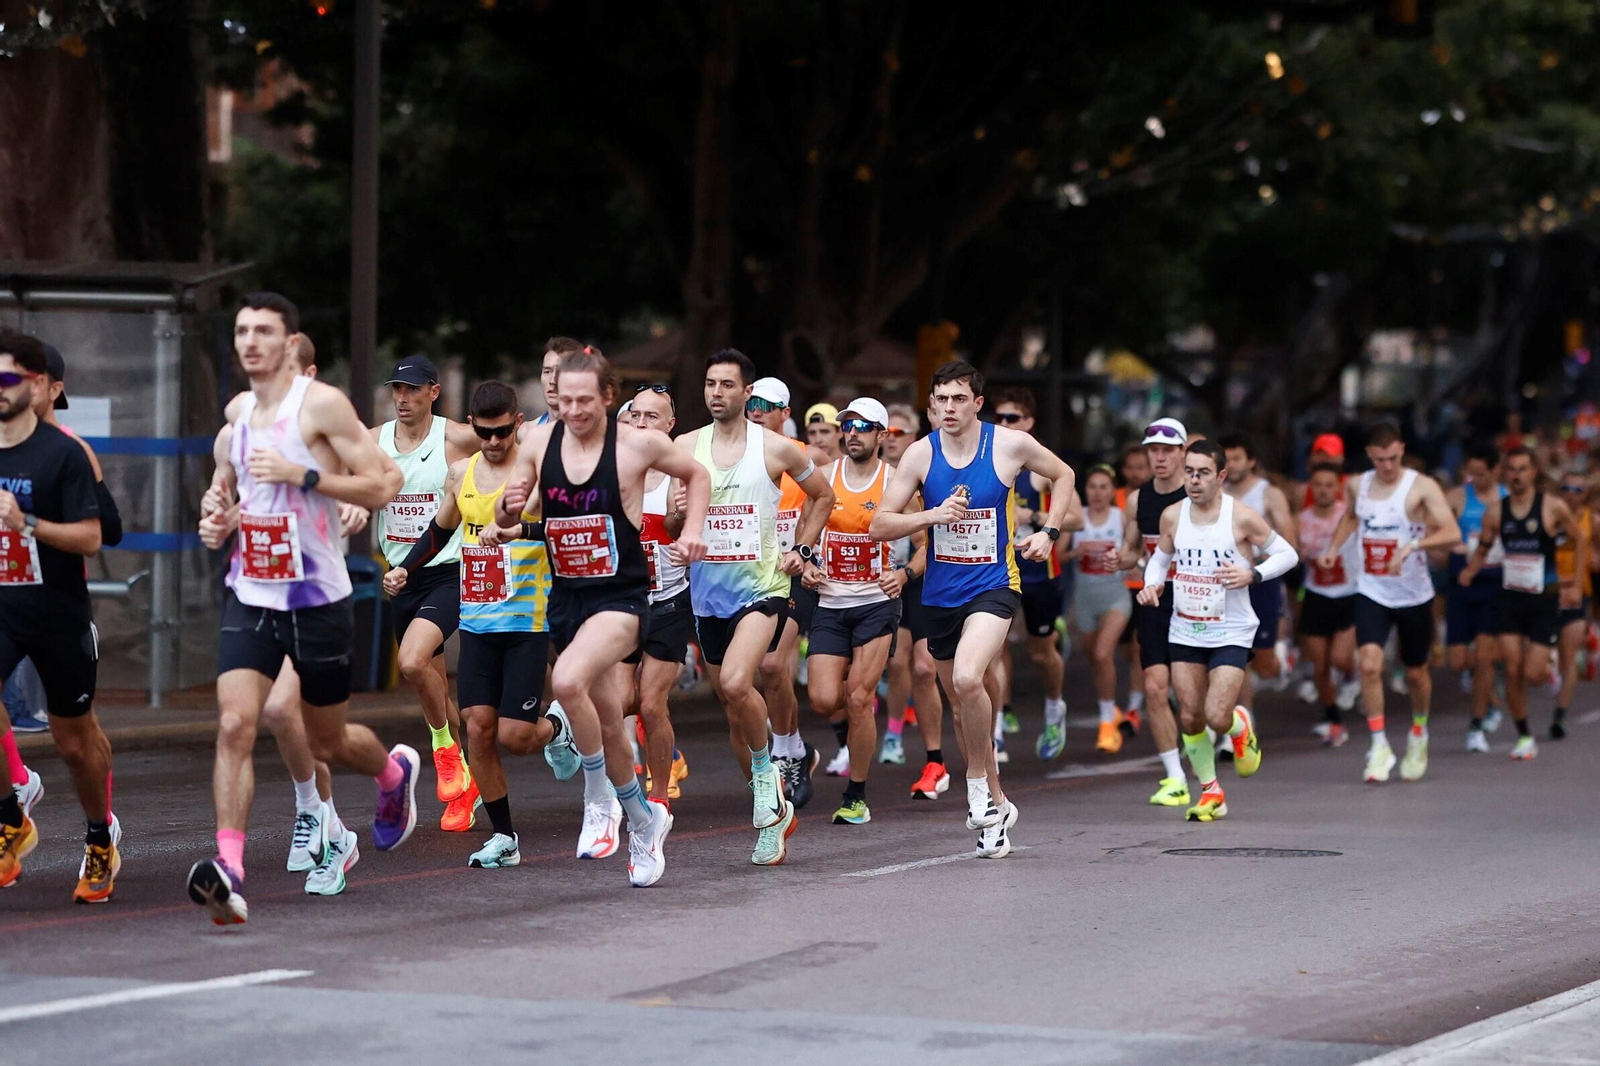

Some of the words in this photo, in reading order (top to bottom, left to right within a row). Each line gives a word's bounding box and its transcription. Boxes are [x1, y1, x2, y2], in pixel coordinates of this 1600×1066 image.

[391, 506, 425, 516] 14592
[711, 505, 750, 514] GENERALI
[962, 511, 987, 519] ERALI
[560, 518, 601, 529] GENERALI
[707, 519, 744, 531] 14532
[777, 523, 790, 532] 53
[946, 523, 981, 534] 14577
[561, 532, 592, 546] 4287
[840, 535, 872, 543] GENERAL
[840, 546, 860, 556] 531
[1183, 585, 1212, 596] 14552
